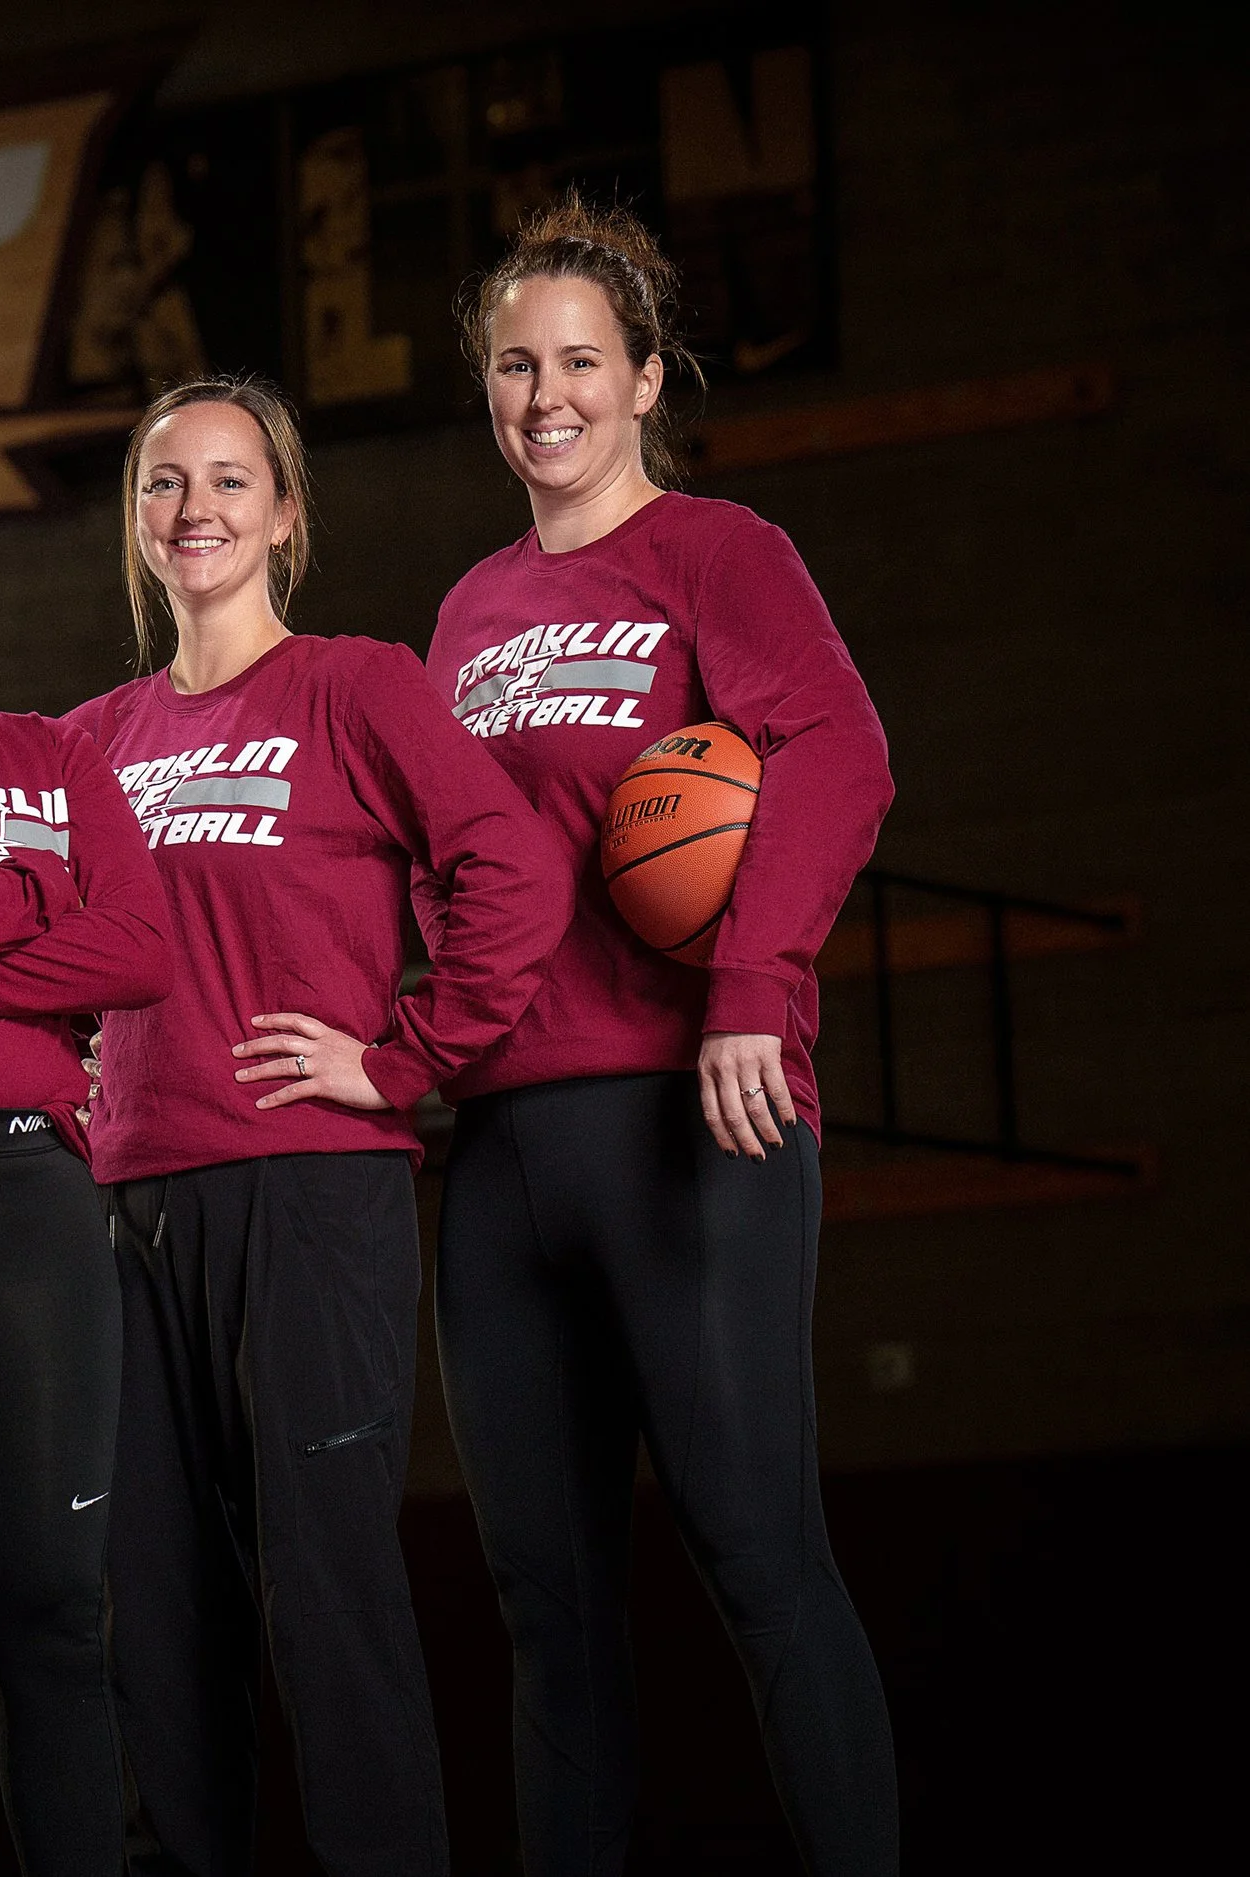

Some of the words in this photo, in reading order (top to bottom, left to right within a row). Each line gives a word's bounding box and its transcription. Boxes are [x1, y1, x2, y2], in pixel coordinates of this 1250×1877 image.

[454, 621, 670, 703] FRANKLIN
[113, 737, 299, 795] ANKLIN
[8, 1115, 51, 1134] NIK
